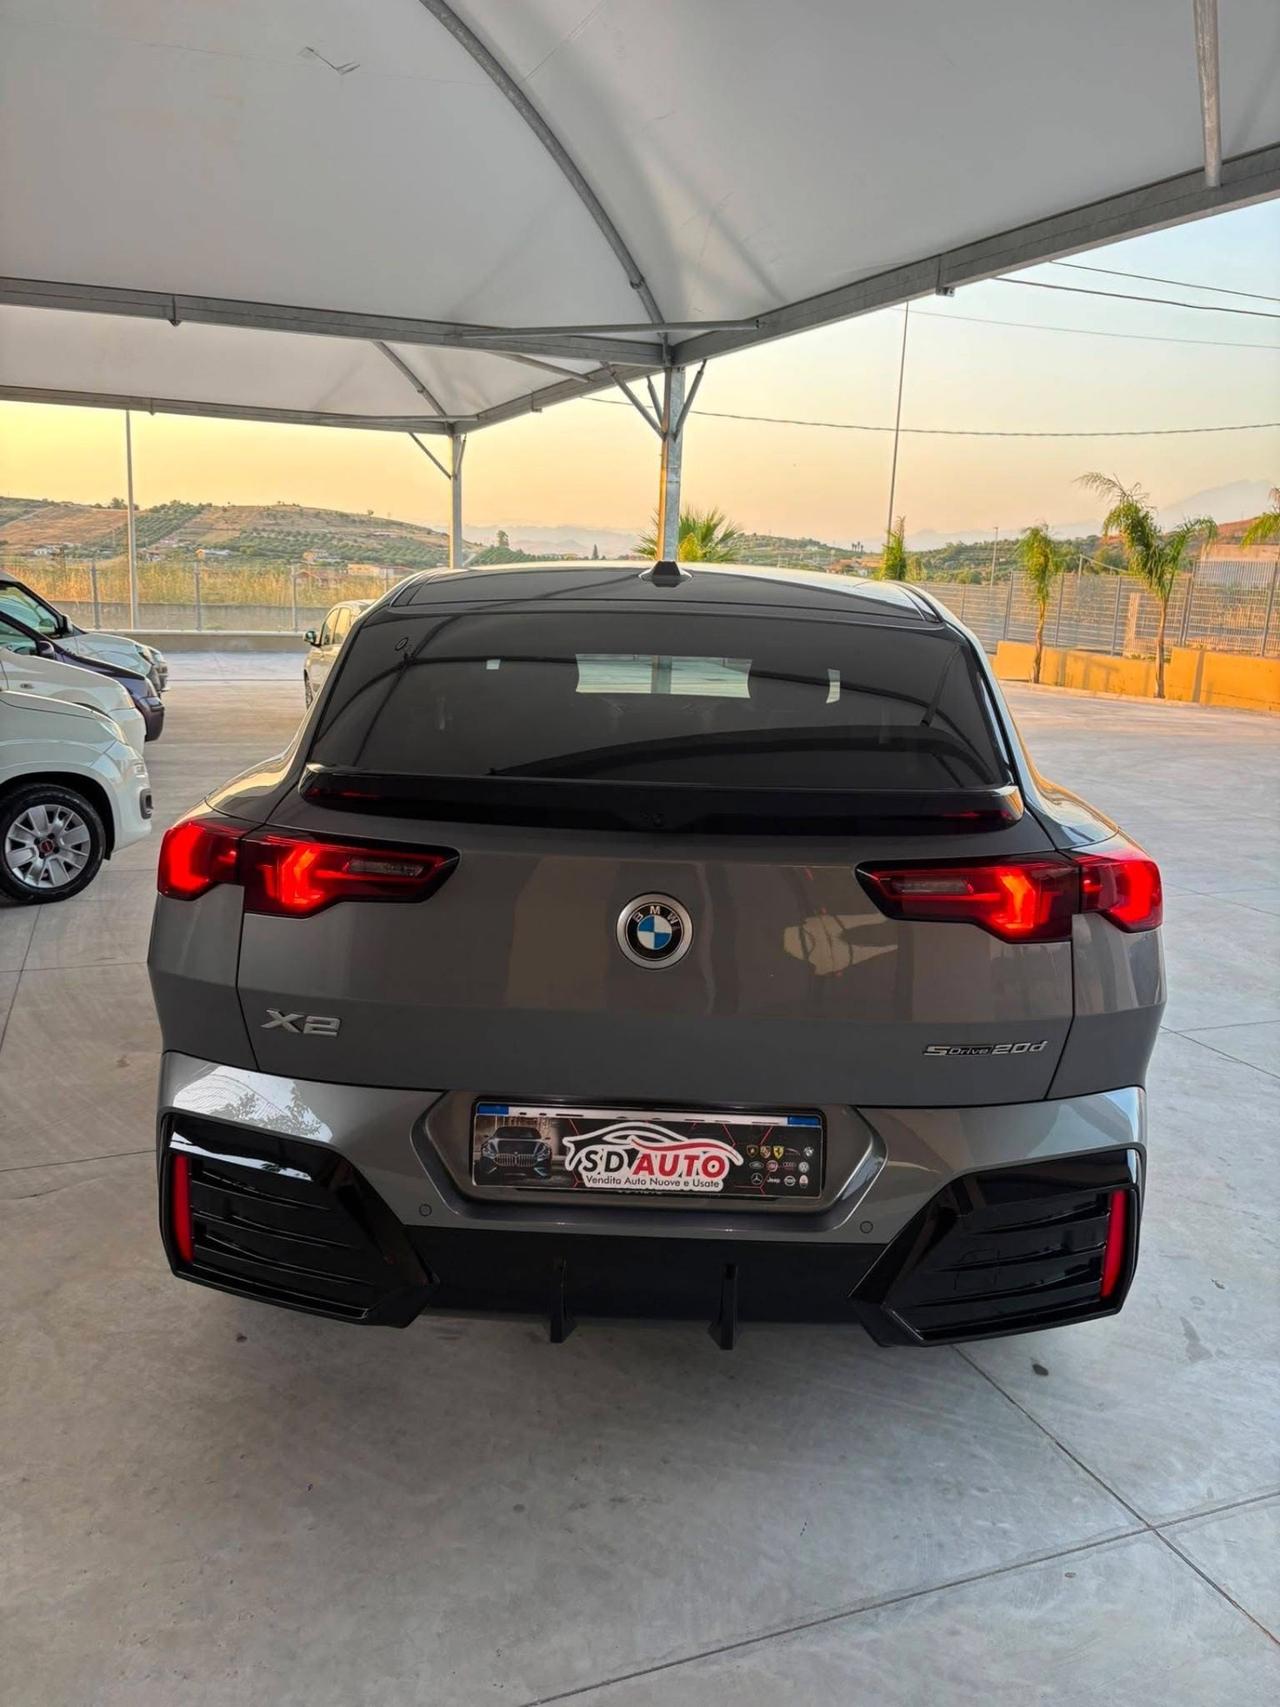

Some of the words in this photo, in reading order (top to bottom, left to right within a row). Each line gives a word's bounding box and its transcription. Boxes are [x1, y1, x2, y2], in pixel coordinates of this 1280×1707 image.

[632, 905, 680, 928] BMW
[260, 1009, 341, 1036] X2
[585, 1175, 621, 1185] Vendita
[623, 1177, 647, 1185] Auto
[649, 1178, 680, 1187] Nuove
[692, 1179, 720, 1188] Usate
